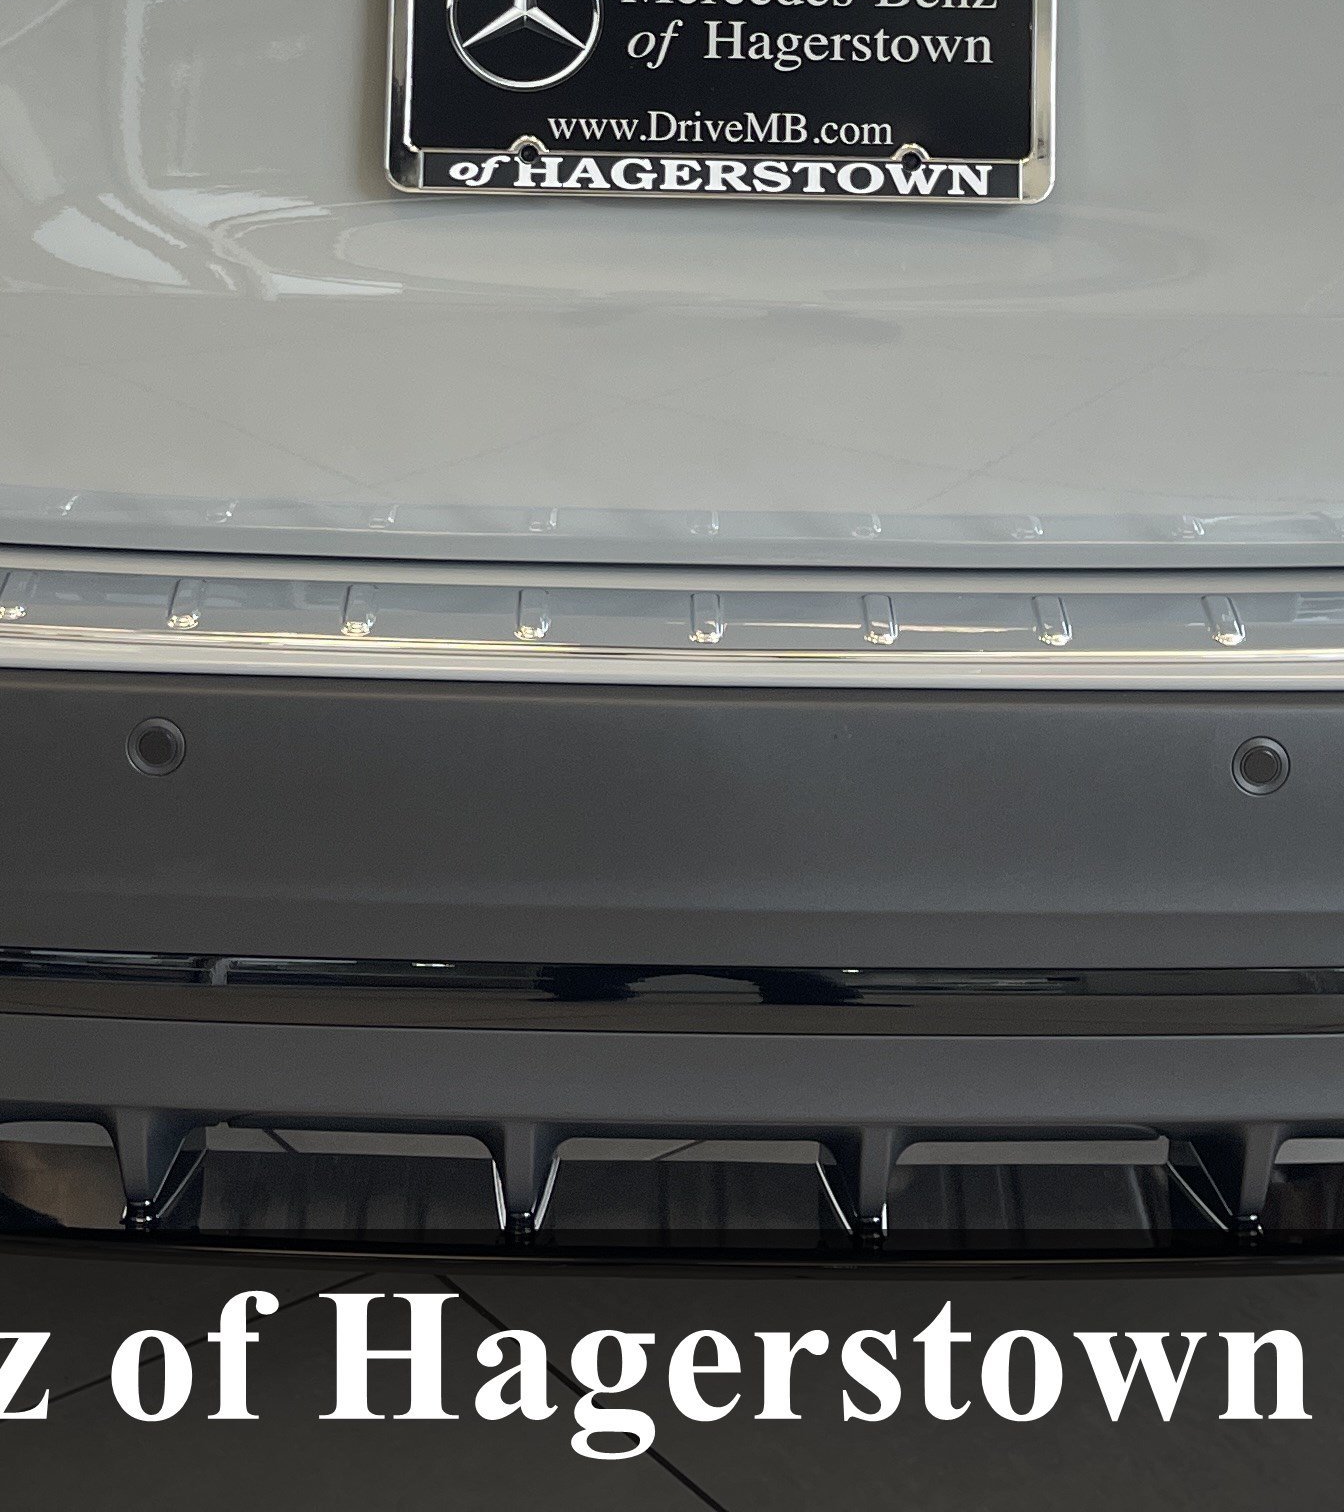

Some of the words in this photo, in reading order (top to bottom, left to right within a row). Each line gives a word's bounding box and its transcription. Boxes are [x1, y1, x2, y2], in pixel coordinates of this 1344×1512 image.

[627, 19, 684, 69] of
[703, 20, 995, 72] Hagerstown
[547, 109, 895, 147] www.DriveMB.com
[448, 155, 511, 187] of
[513, 155, 994, 197] HAGERSTOWN
